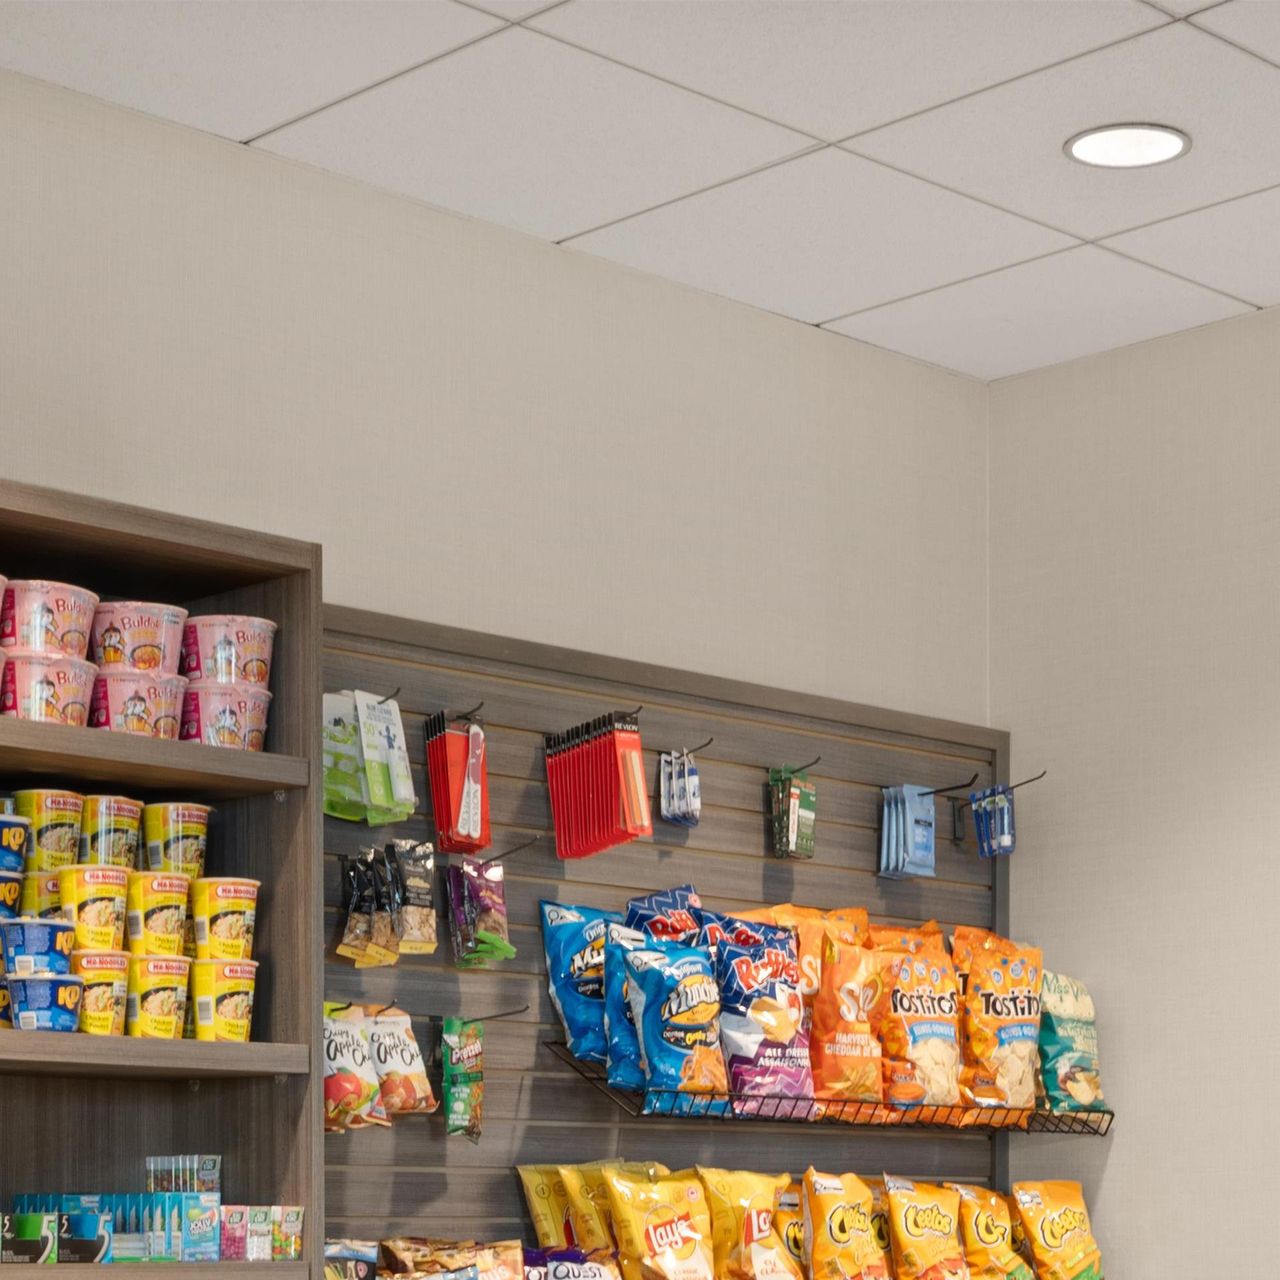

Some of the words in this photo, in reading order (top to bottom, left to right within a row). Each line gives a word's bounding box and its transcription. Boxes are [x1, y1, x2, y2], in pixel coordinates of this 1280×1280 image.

[732, 949, 800, 992] Ruffles
[662, 976, 720, 1021] Munchie
[981, 988, 1040, 1016] TOSTITO
[765, 1048, 783, 1058] ALL
[552, 1263, 603, 1280] QUEST
